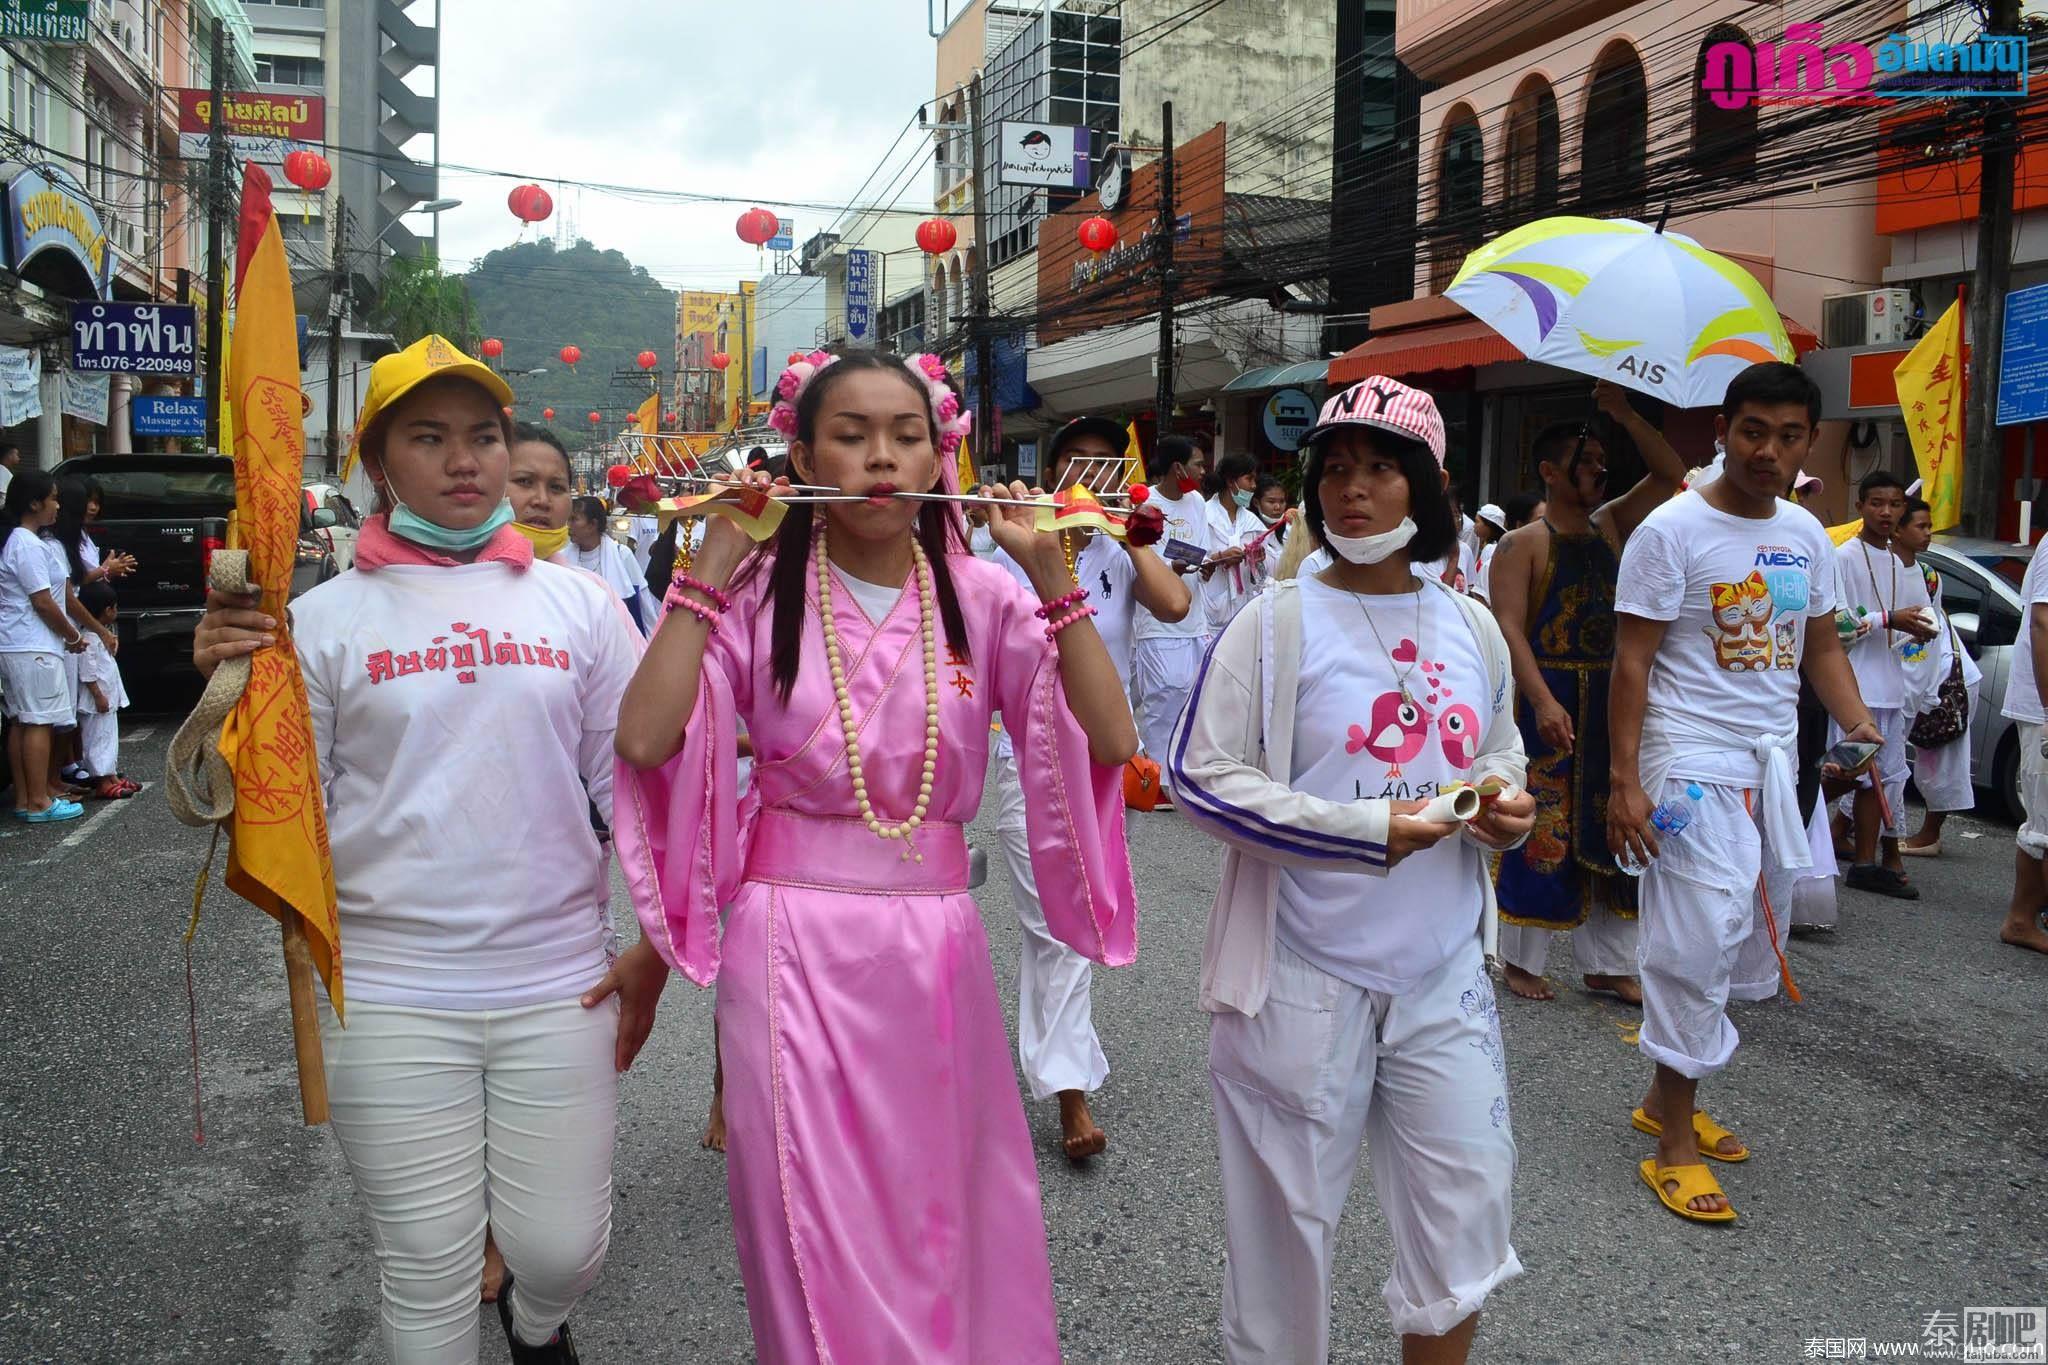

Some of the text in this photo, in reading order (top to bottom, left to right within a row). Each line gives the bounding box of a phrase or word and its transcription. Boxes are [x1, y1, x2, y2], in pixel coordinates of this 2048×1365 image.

[75, 305, 193, 354] ทำฟัน
[1616, 354, 1667, 385] AIS
[152, 400, 199, 415] Relax
[1330, 384, 1403, 418] NY
[140, 415, 181, 427] Massage
[192, 417, 206, 428] Sp
[1768, 545, 1792, 553] TOYOTA
[1754, 552, 1809, 569] NEXT
[1737, 649, 1762, 657] NEXT
